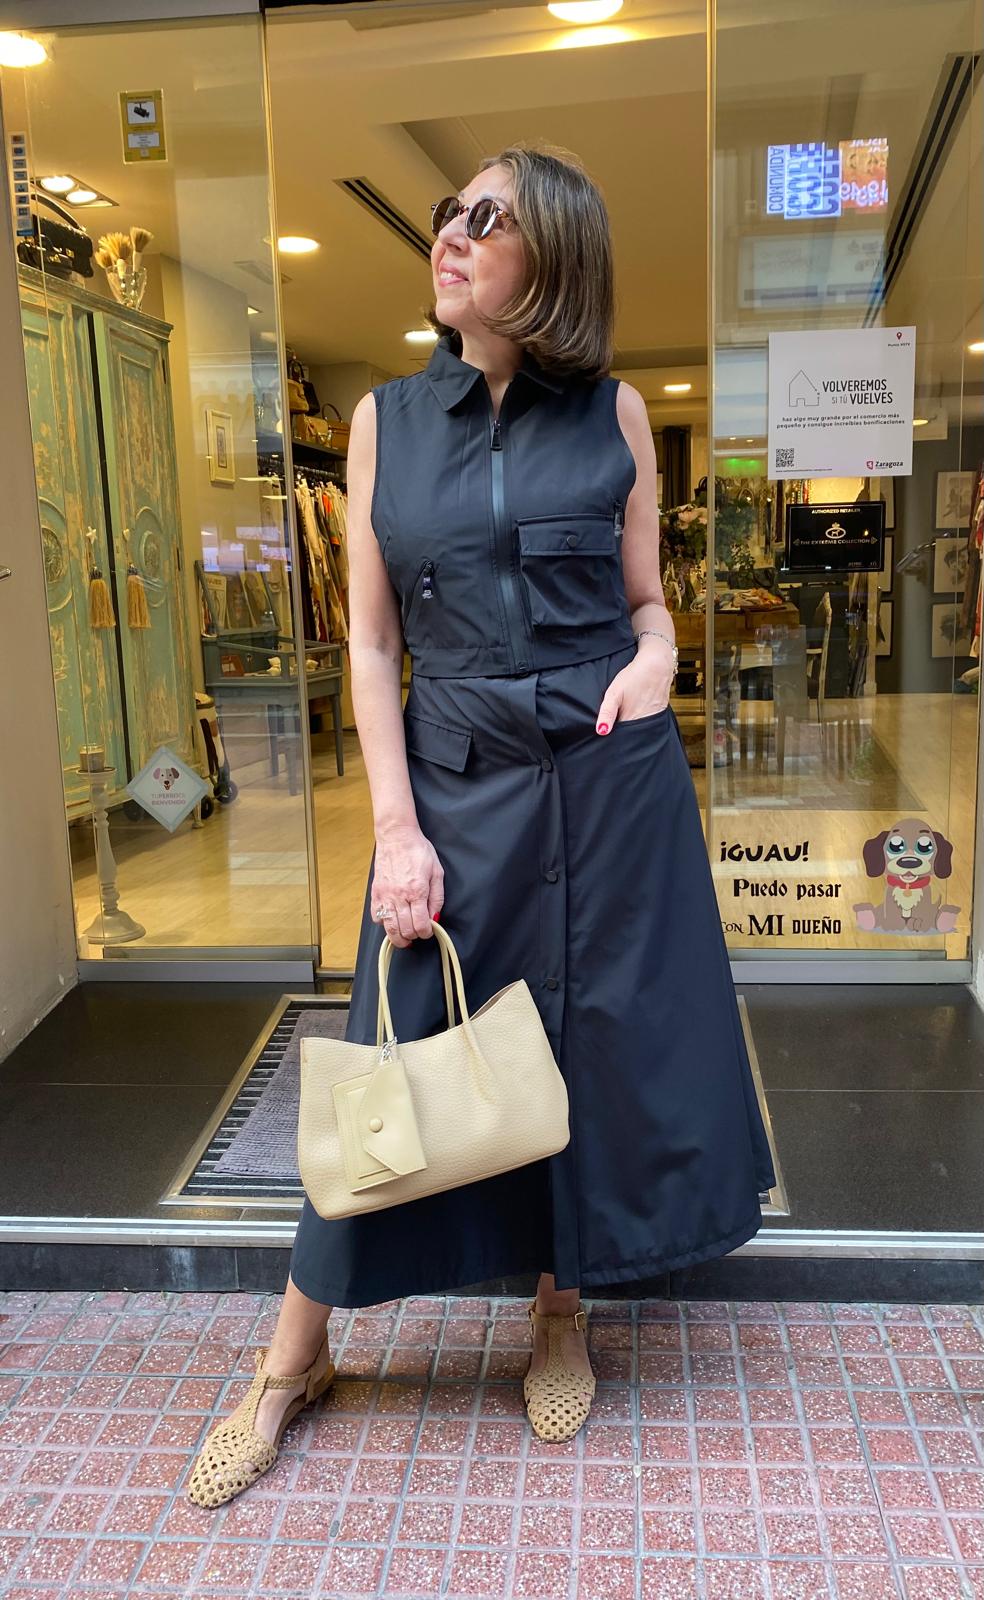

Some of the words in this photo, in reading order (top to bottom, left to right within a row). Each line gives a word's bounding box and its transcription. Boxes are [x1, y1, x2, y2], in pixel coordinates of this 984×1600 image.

[822, 379, 887, 392] VOLVEREMOS
[831, 396, 837, 404] SI
[850, 392, 893, 405] VUELVES
[875, 461, 903, 469] Zaragoza
[733, 878, 788, 898] Puedo
[797, 882, 841, 900] pasar
[748, 914, 785, 936] MI
[792, 916, 841, 934] DUEÑO
